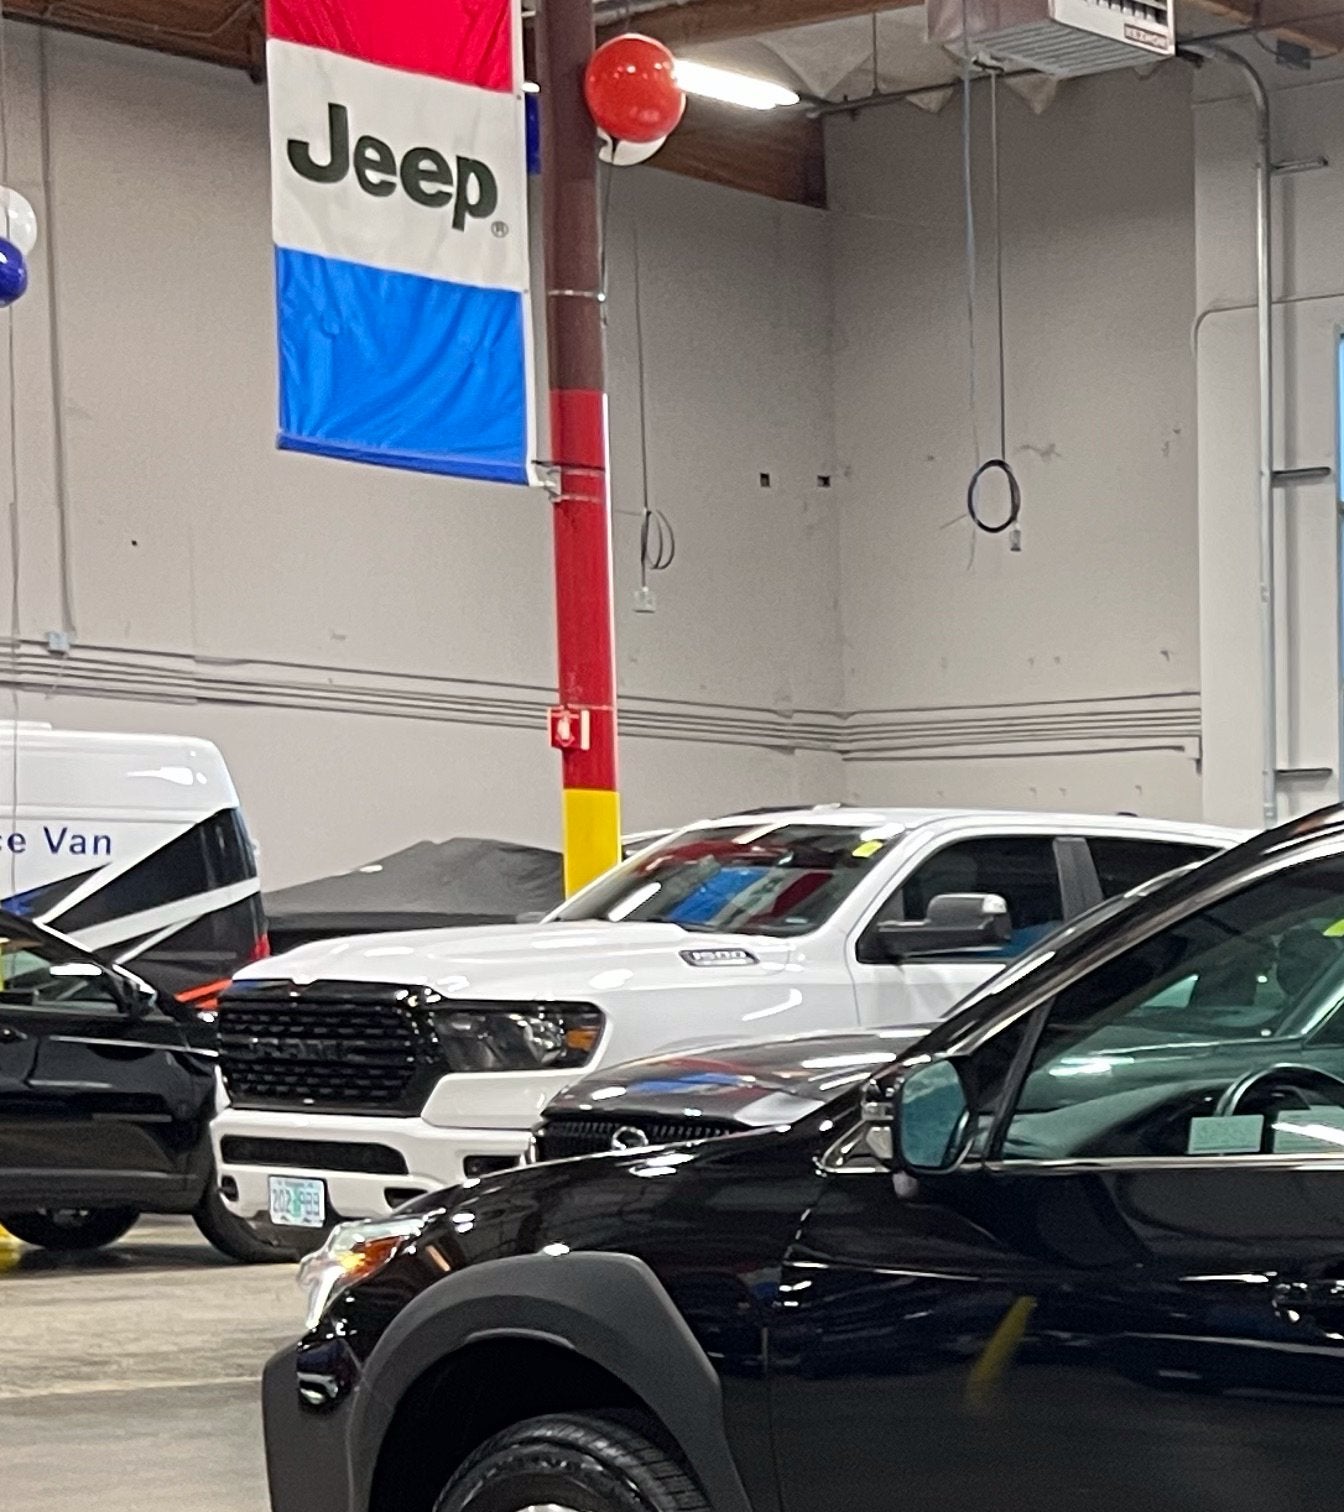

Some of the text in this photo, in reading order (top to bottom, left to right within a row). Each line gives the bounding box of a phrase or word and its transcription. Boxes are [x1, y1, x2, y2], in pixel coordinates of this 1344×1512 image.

[286, 102, 498, 232] Jeep
[0, 825, 111, 855] e Van
